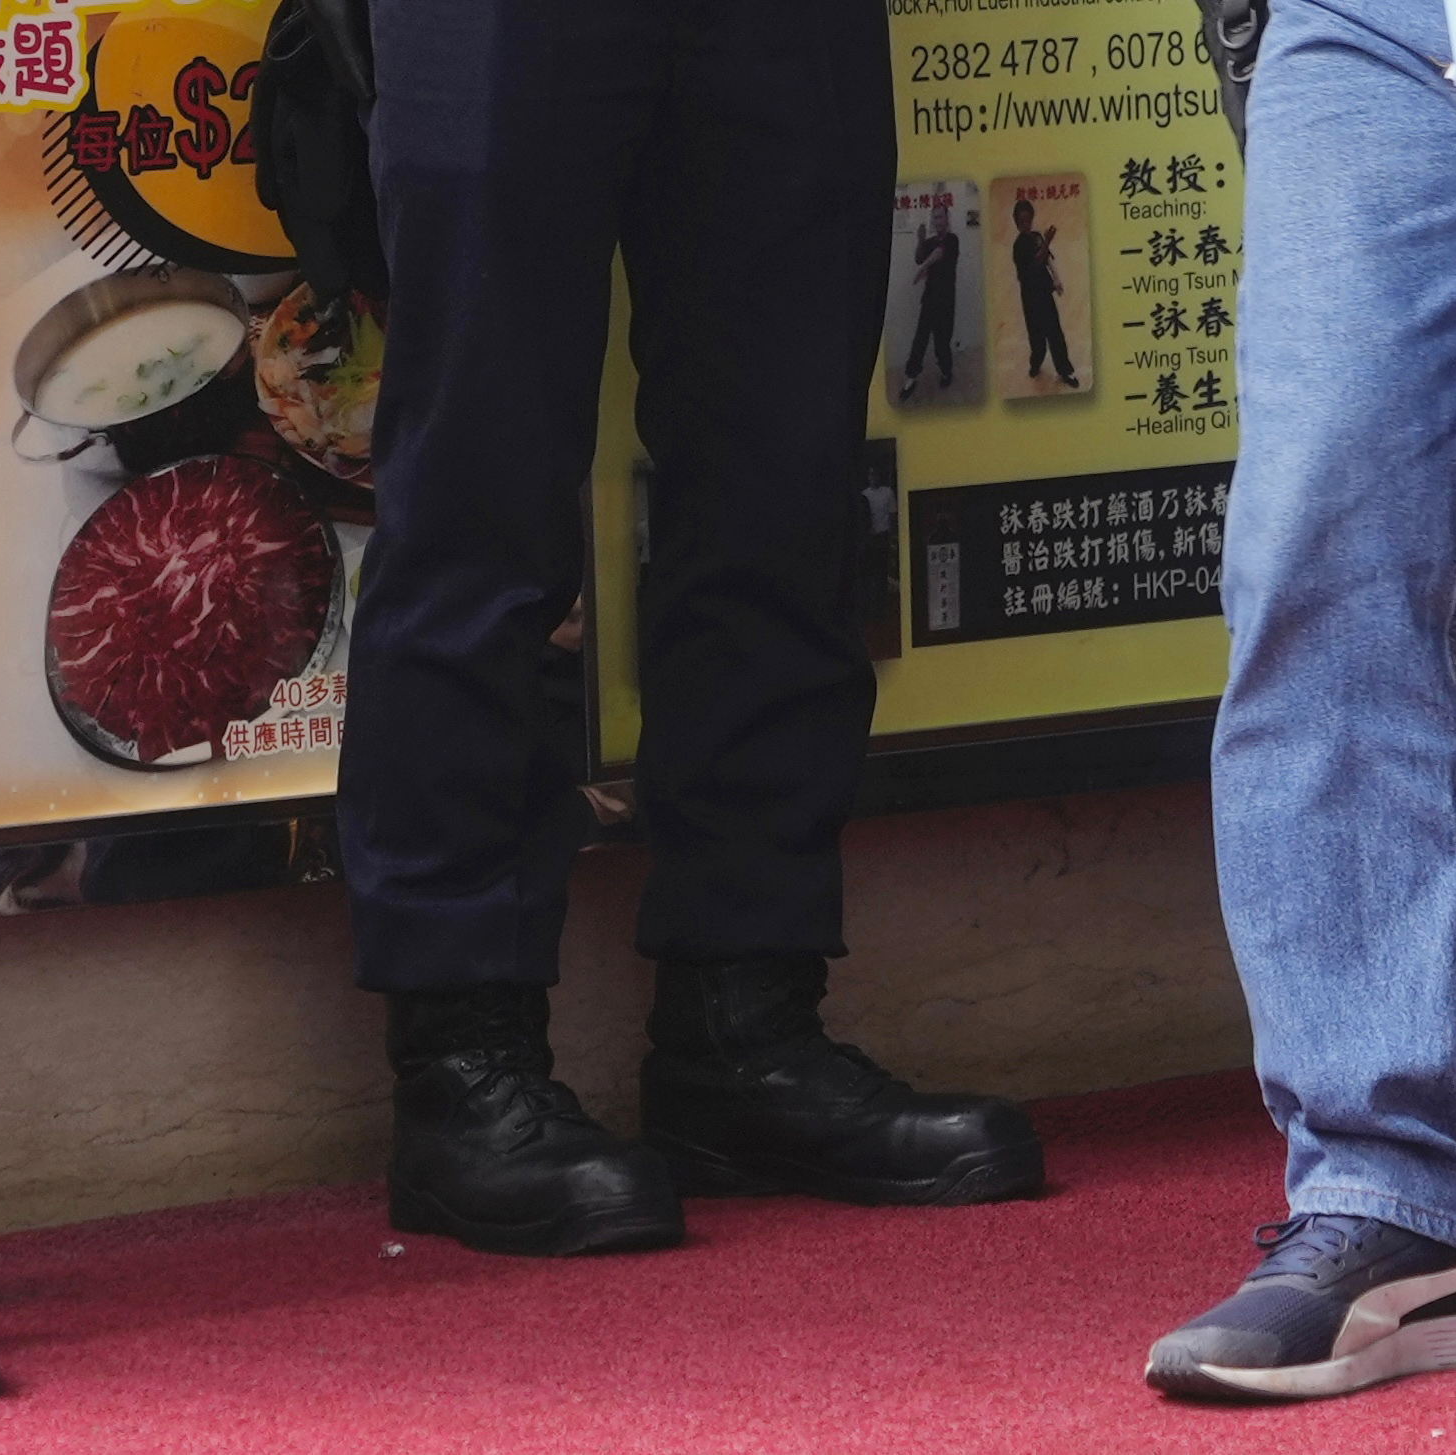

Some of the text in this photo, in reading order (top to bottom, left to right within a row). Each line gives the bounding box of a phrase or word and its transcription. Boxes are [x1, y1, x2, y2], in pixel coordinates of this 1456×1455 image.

[911, 42, 992, 83] 2382
[1000, 37, 1079, 77] 4787
[1107, 30, 1185, 70] 6078
[913, 84, 1226, 142] http://www.wingtsu
[1119, 198, 1207, 220] Teaching:
[1184, 272, 1226, 290] Tsun
[1186, 347, 1228, 365] Tsun
[1211, 410, 1231, 429] Qi
